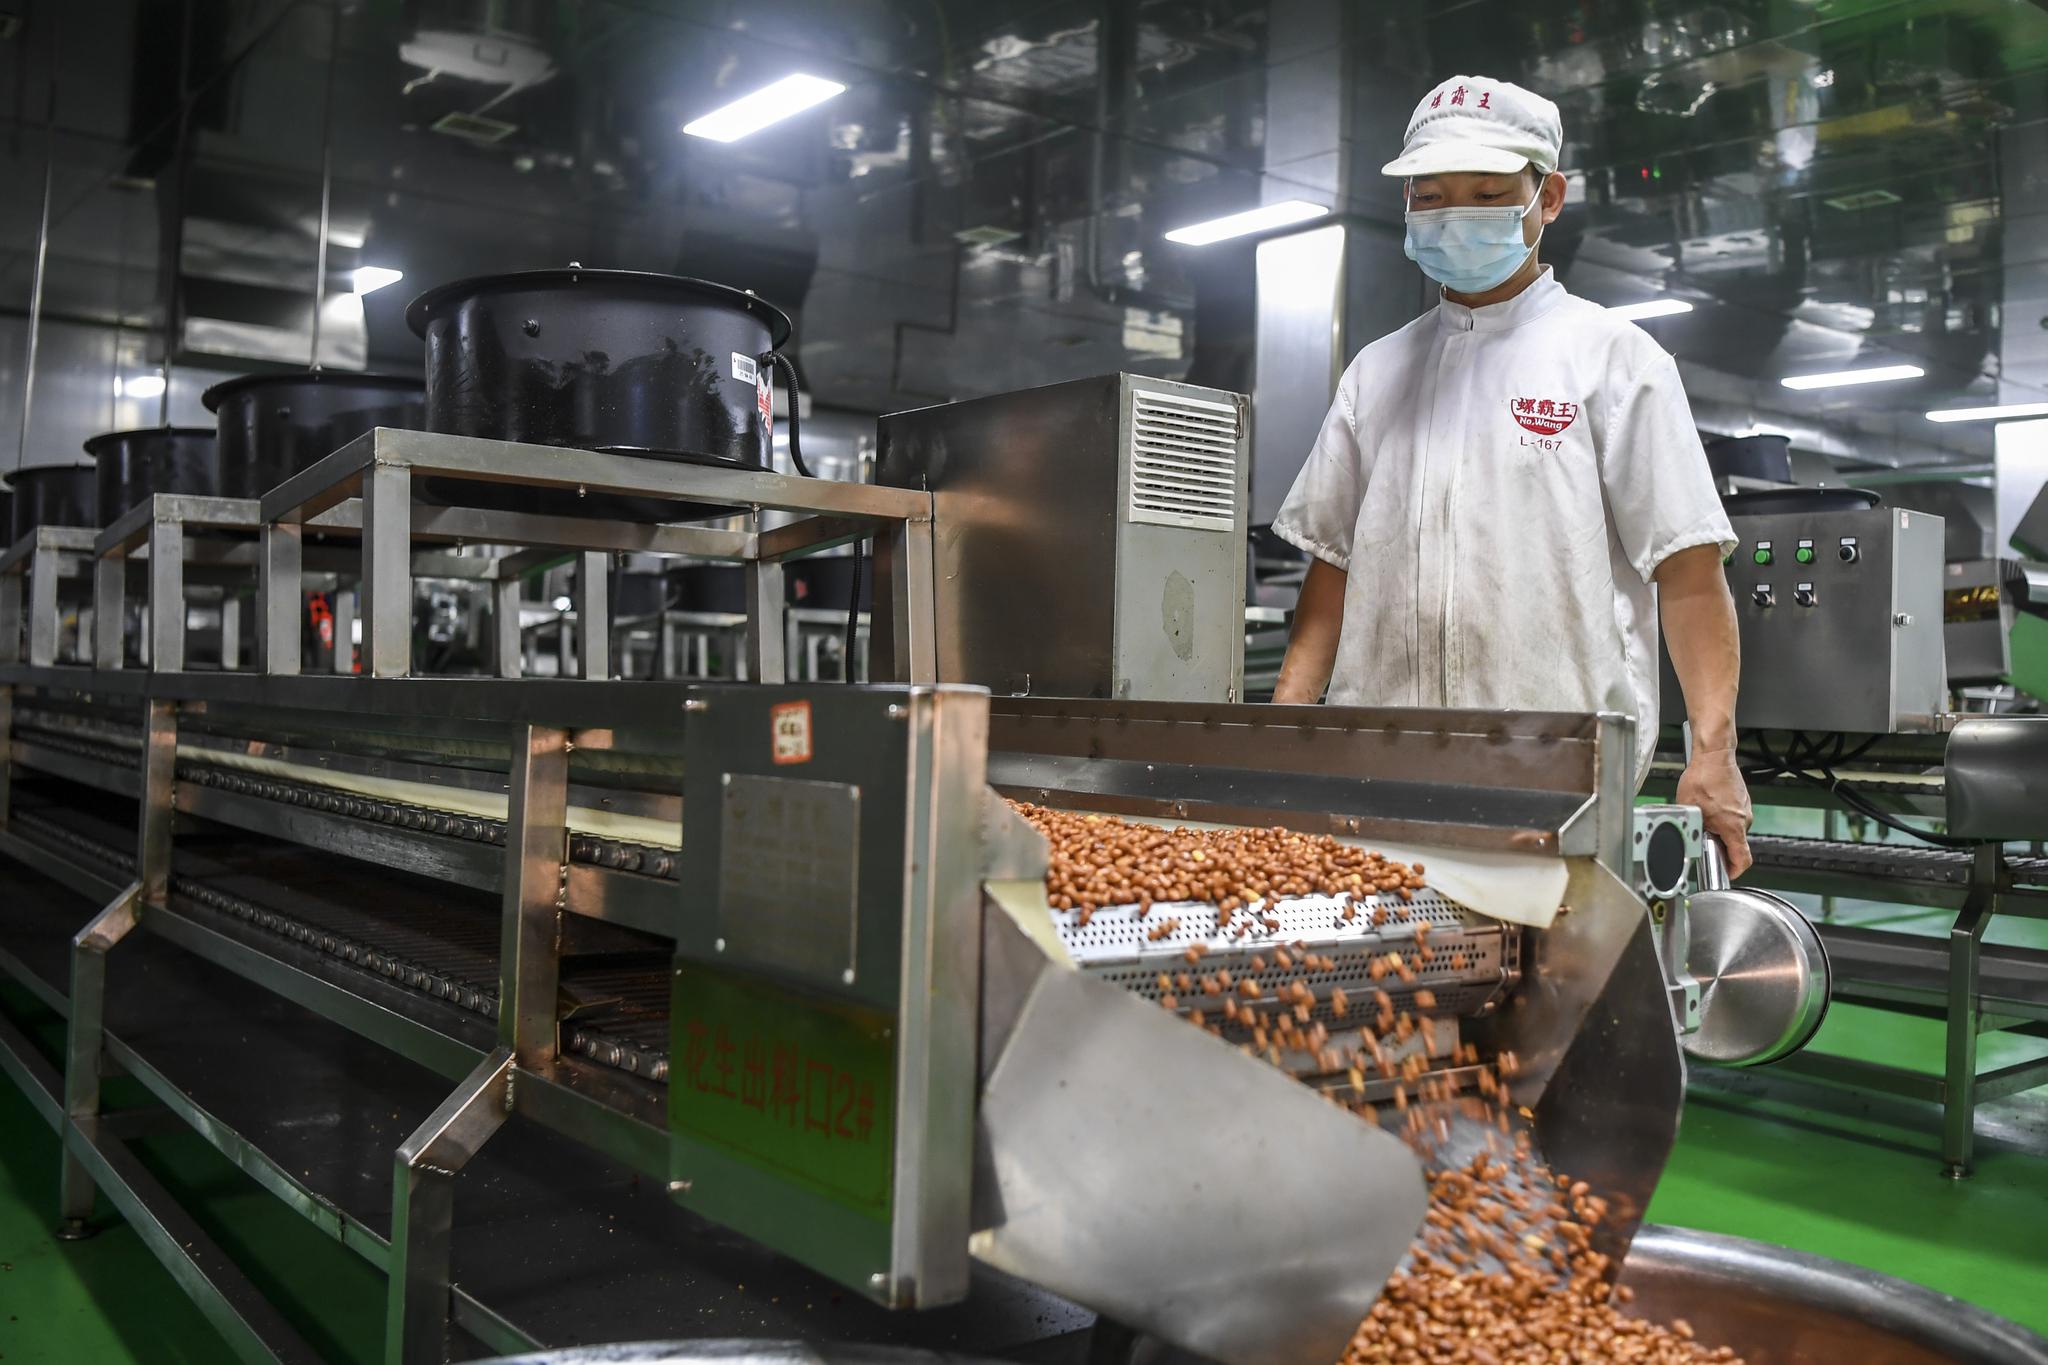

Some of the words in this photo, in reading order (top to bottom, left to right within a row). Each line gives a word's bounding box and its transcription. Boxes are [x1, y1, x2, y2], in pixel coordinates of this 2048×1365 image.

[1516, 397, 1573, 418] 螺霸王
[1520, 436, 1562, 451] L-167
